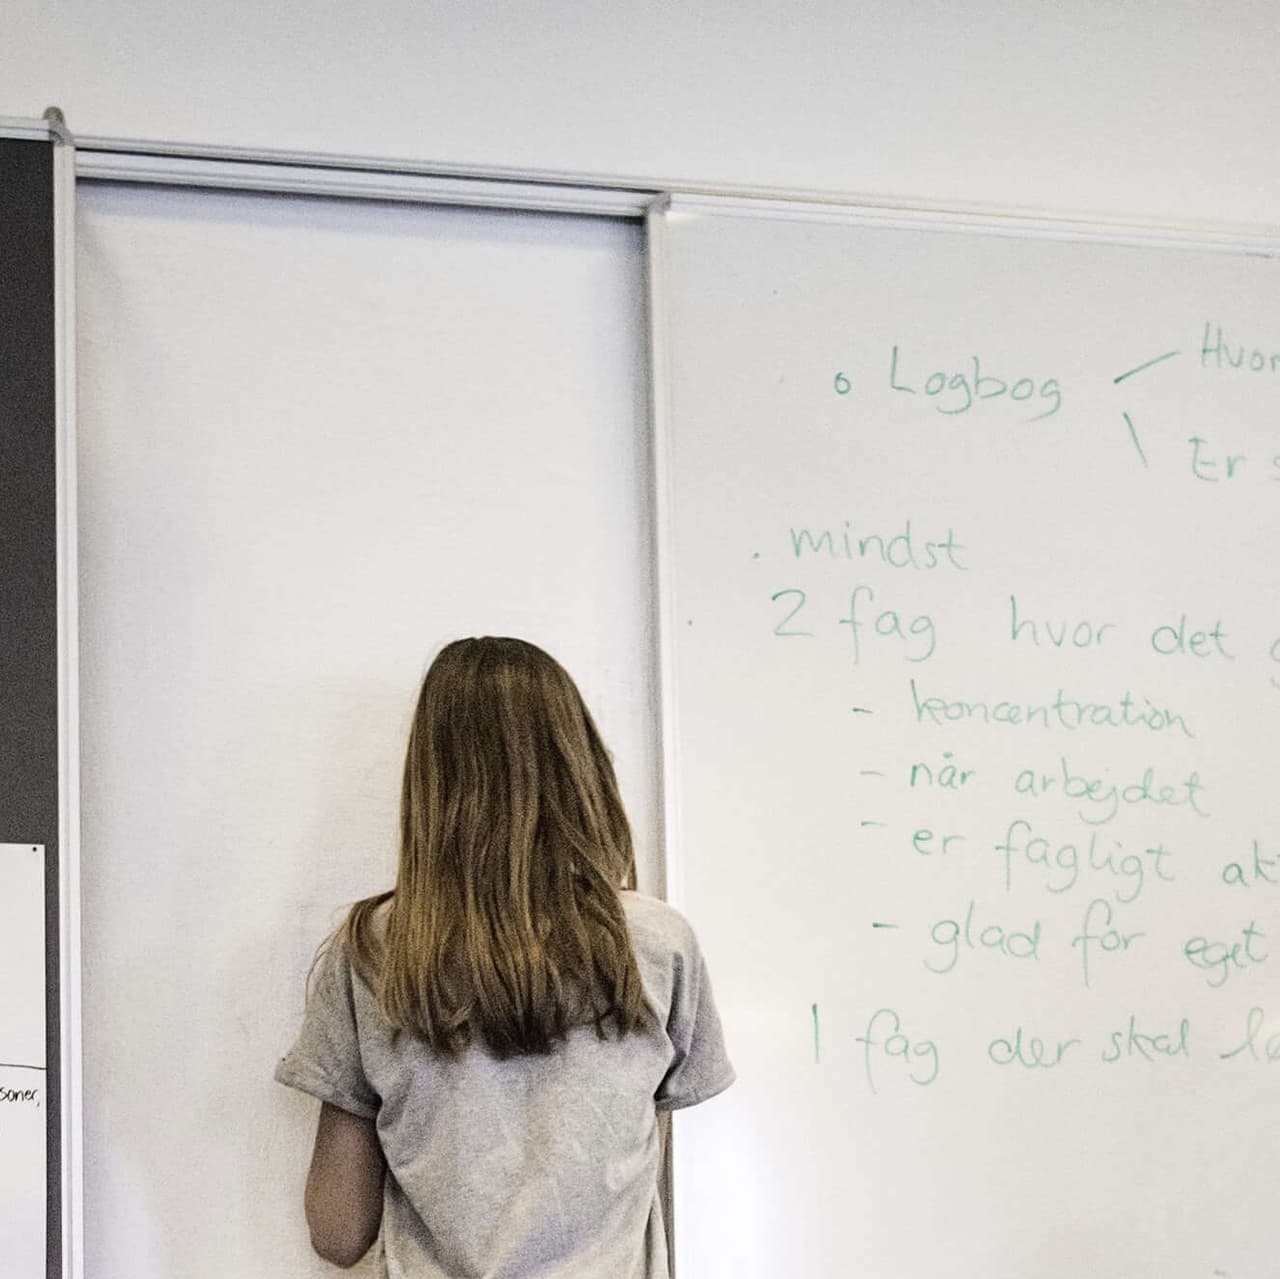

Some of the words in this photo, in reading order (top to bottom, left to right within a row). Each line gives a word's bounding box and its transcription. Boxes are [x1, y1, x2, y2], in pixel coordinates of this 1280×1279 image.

[890, 345, 1062, 422] Logbog
[1188, 437, 1247, 482] Er
[789, 520, 968, 570] mindst
[771, 588, 814, 636] 2
[839, 586, 937, 663] fag
[1010, 594, 1117, 647] hvor
[1152, 614, 1237, 659] det
[909, 679, 1196, 738] koncentration
[910, 752, 976, 788] når
[1015, 757, 1210, 825] arbejdet
[912, 829, 966, 855] er
[995, 820, 1176, 901] fagligt
[923, 900, 1040, 974] glad
[1072, 899, 1145, 988] for
[1184, 921, 1268, 987] eget
[856, 1009, 939, 1095] fag
[988, 1027, 1081, 1068] der
[1102, 1015, 1190, 1062] skal
